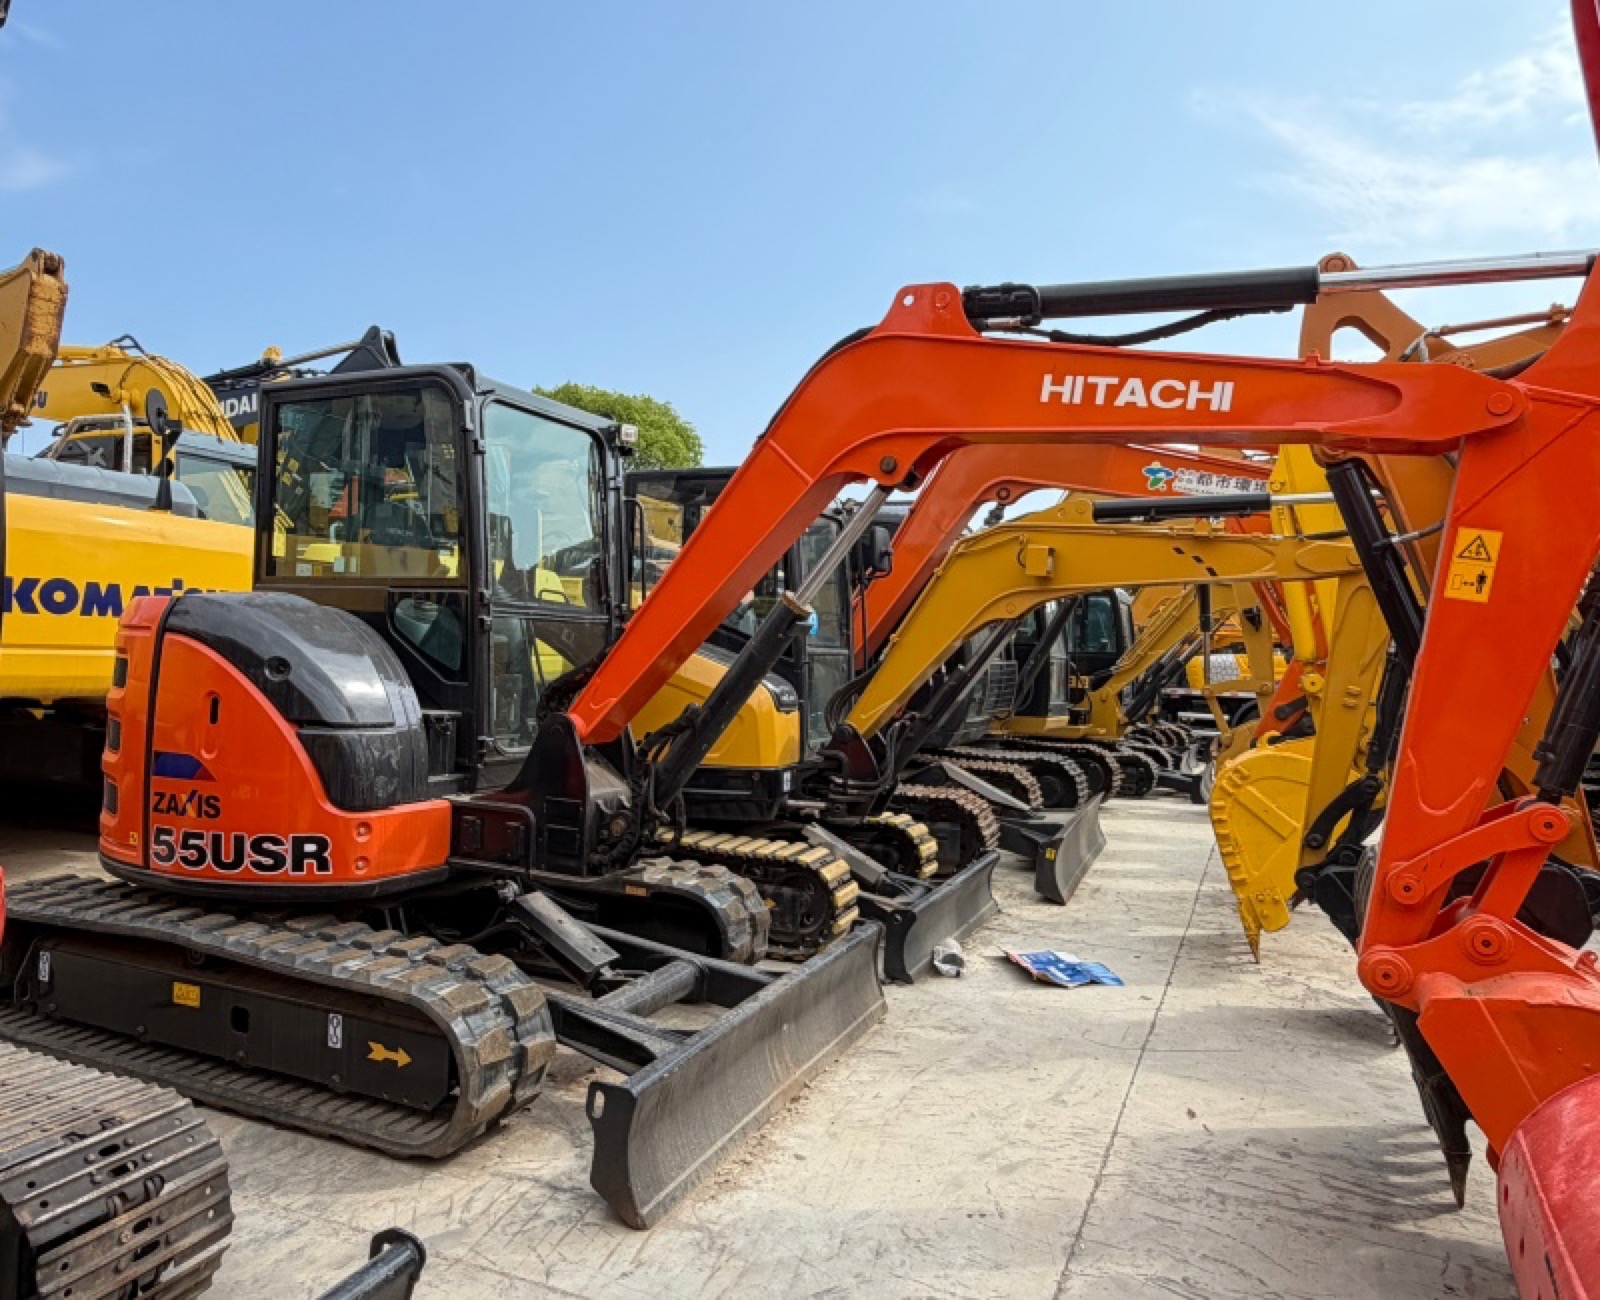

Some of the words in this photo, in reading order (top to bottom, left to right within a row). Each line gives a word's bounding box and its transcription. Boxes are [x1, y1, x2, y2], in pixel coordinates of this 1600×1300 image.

[1039, 373, 1235, 412] HITACHI
[152, 789, 221, 819] ZAXIS
[152, 824, 333, 876] 55USR
